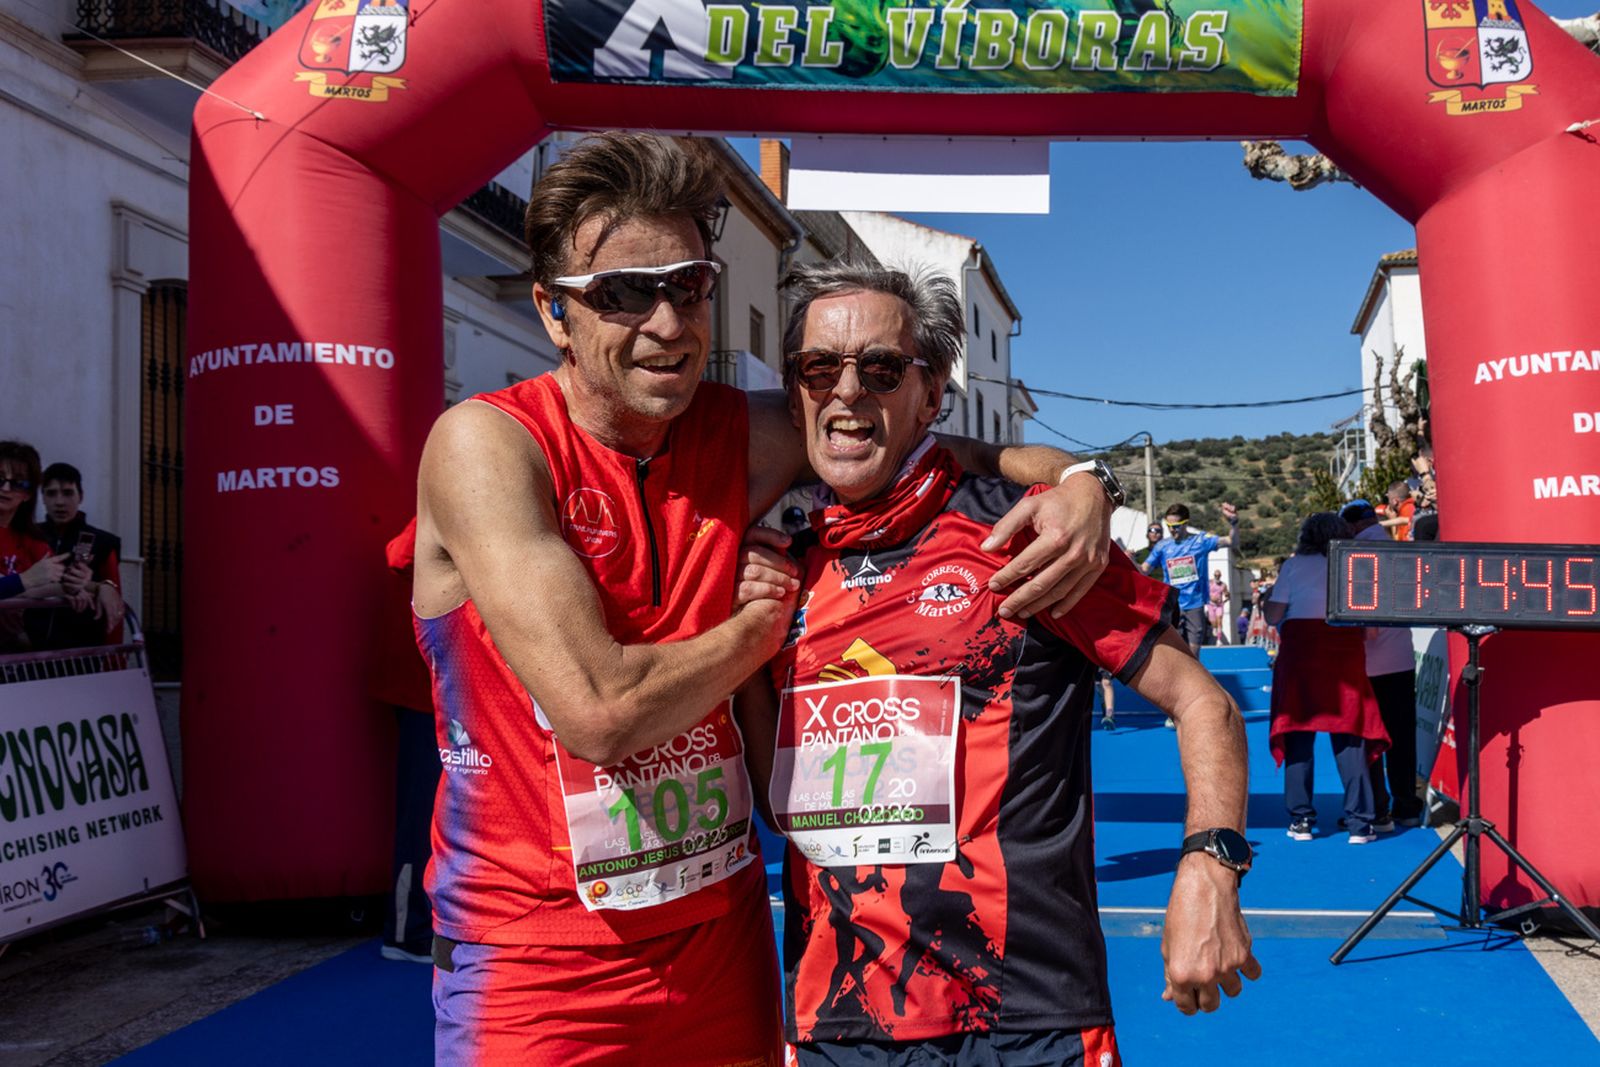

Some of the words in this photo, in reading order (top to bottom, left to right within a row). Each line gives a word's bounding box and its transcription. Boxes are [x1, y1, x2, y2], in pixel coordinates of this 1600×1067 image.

[705, 4, 845, 67] DEL
[886, 0, 1230, 72] VÍBORAS
[324, 86, 372, 98] MARTOS
[1460, 97, 1508, 113] MARTOS
[189, 342, 394, 378] AYUNTAMIENTO
[254, 404, 294, 426] DE
[217, 466, 339, 492] MARTOS
[914, 598, 971, 618] Martos
[803, 695, 829, 730] X
[832, 696, 921, 728] CROSS
[801, 722, 895, 753] PANTANO
[438, 747, 493, 768] astillo
[594, 754, 706, 796] PANTANO
[822, 741, 893, 807] 17
[888, 778, 916, 798] 20
[608, 766, 729, 851] 105
[791, 812, 841, 829] MANUEL
[0, 826, 80, 864] CHISING
[86, 805, 163, 840] NETWORK
[578, 857, 639, 878] ANTONIO
[641, 846, 679, 865] JESUS
